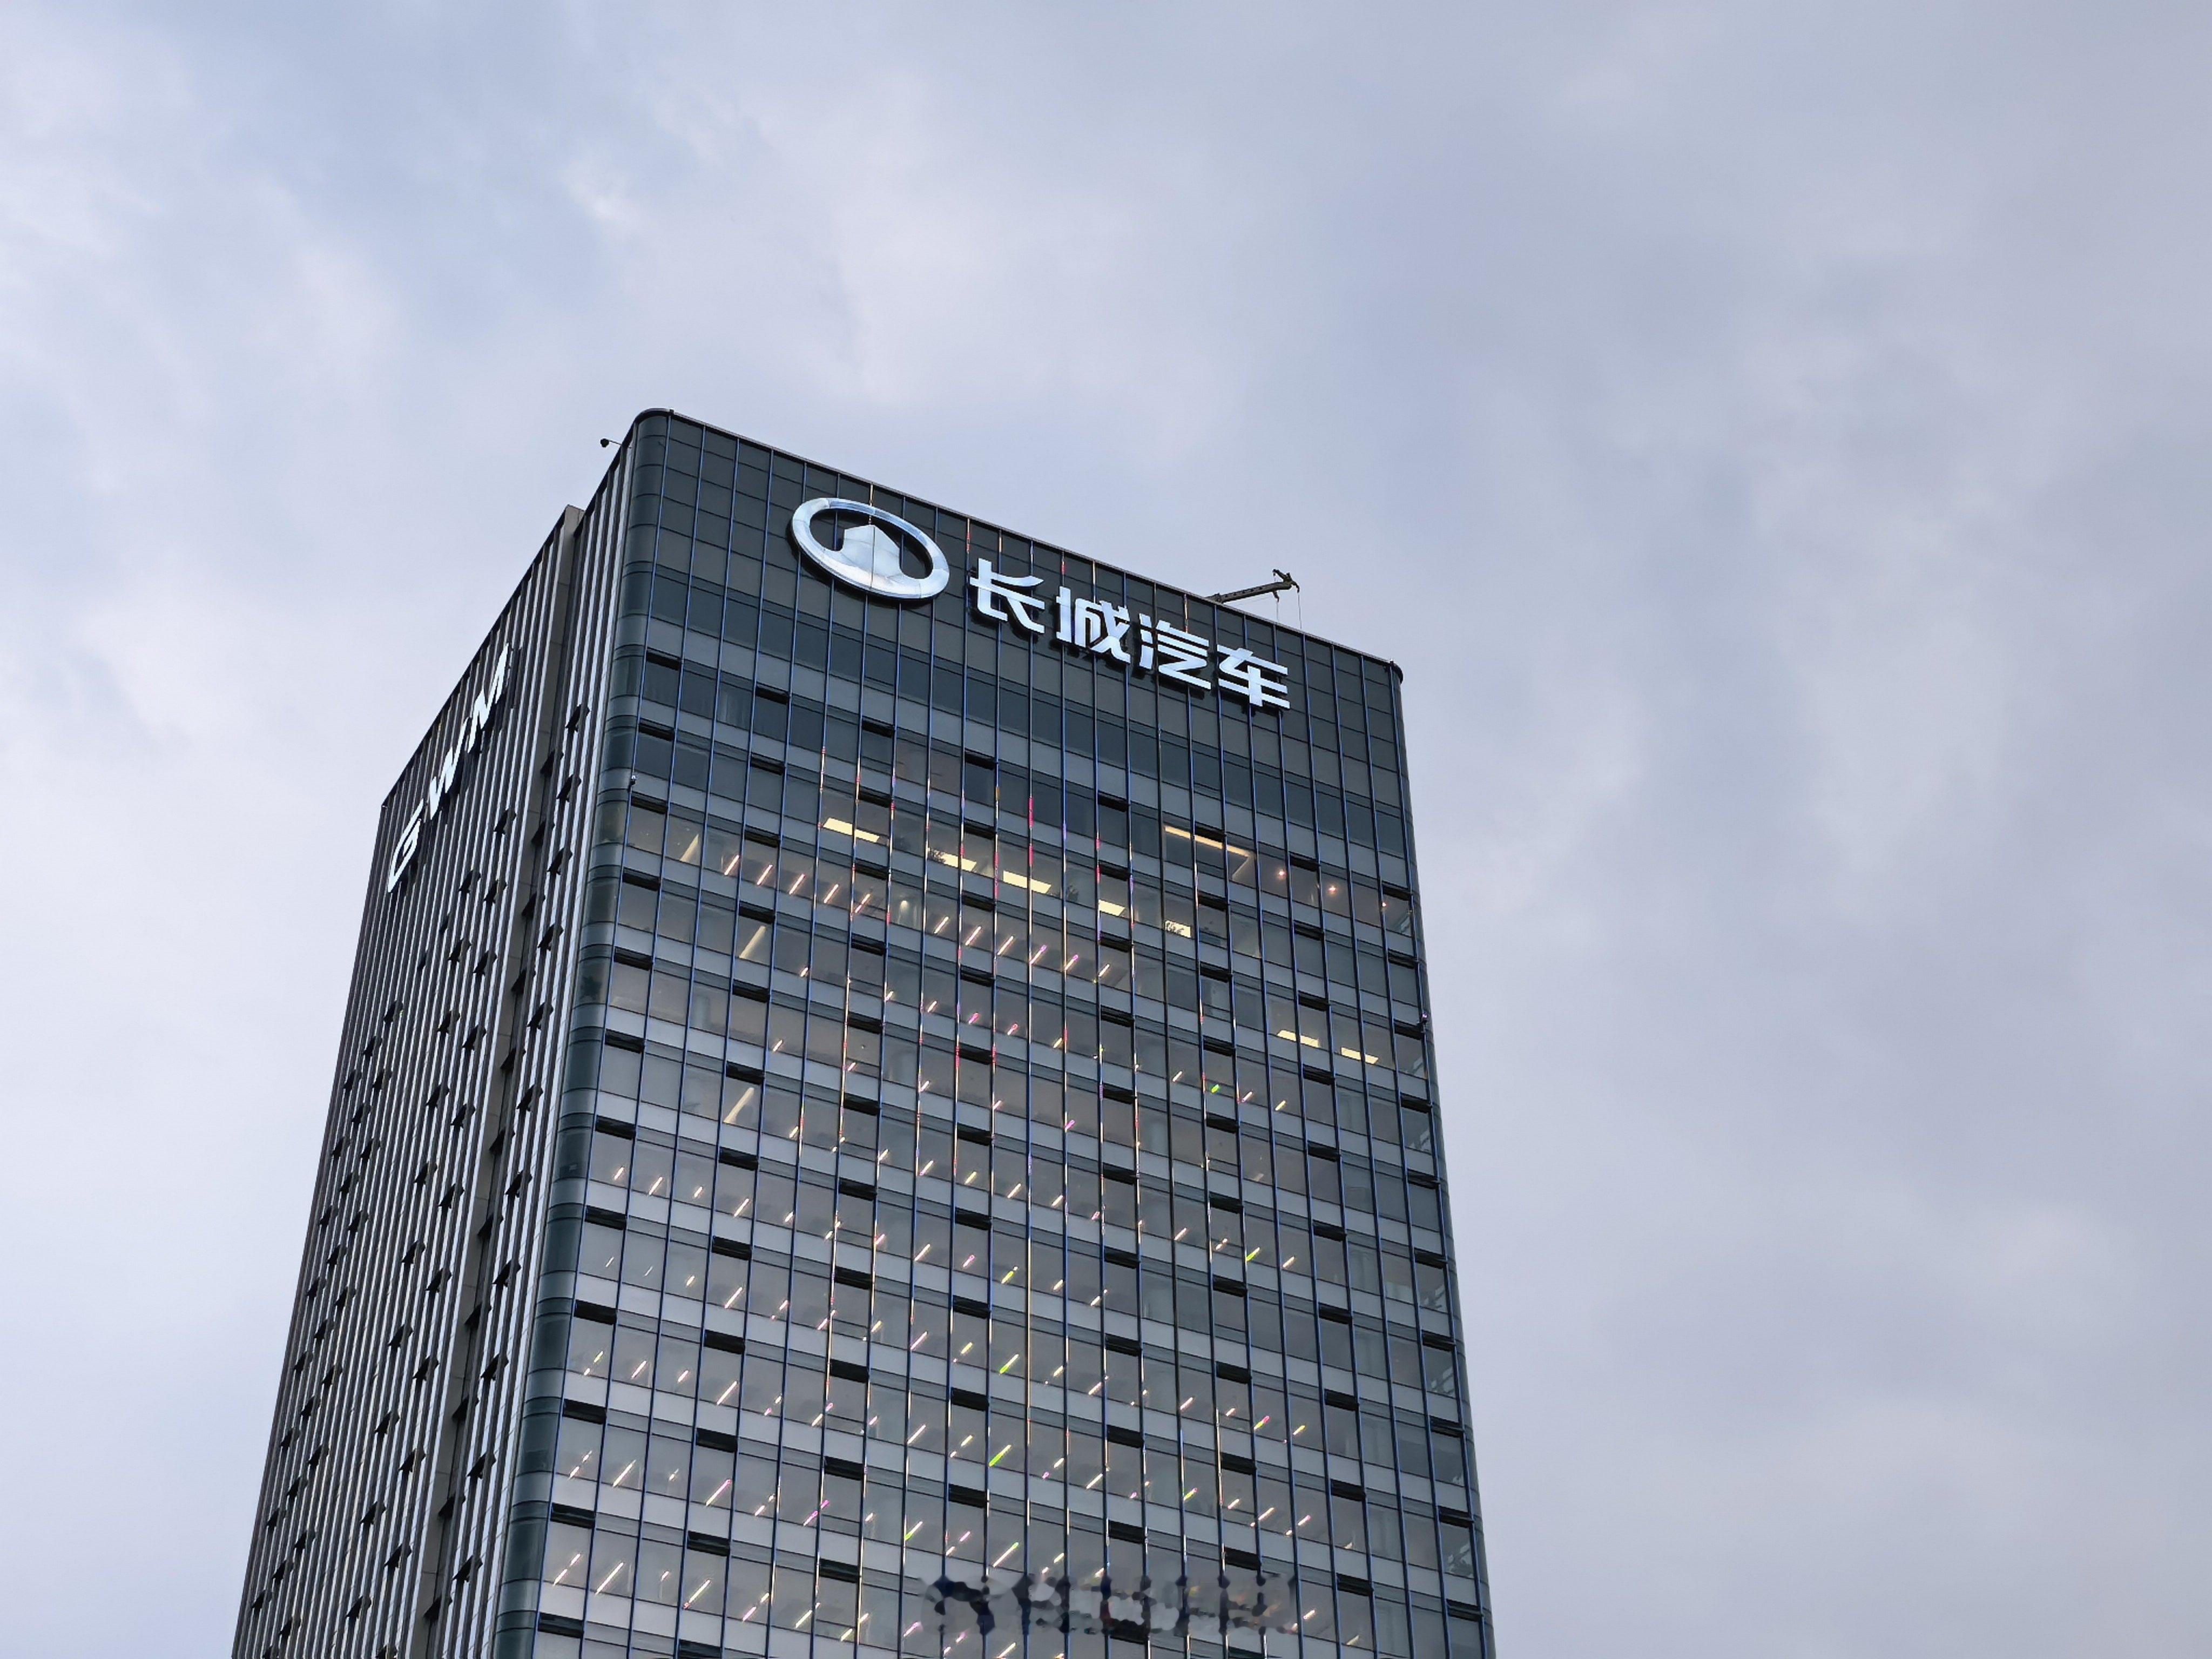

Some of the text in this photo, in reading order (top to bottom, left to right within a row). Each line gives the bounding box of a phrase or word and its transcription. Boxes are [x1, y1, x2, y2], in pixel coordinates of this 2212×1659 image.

[970, 558, 1289, 709] 长城汽车
[388, 643, 509, 893] GWM
